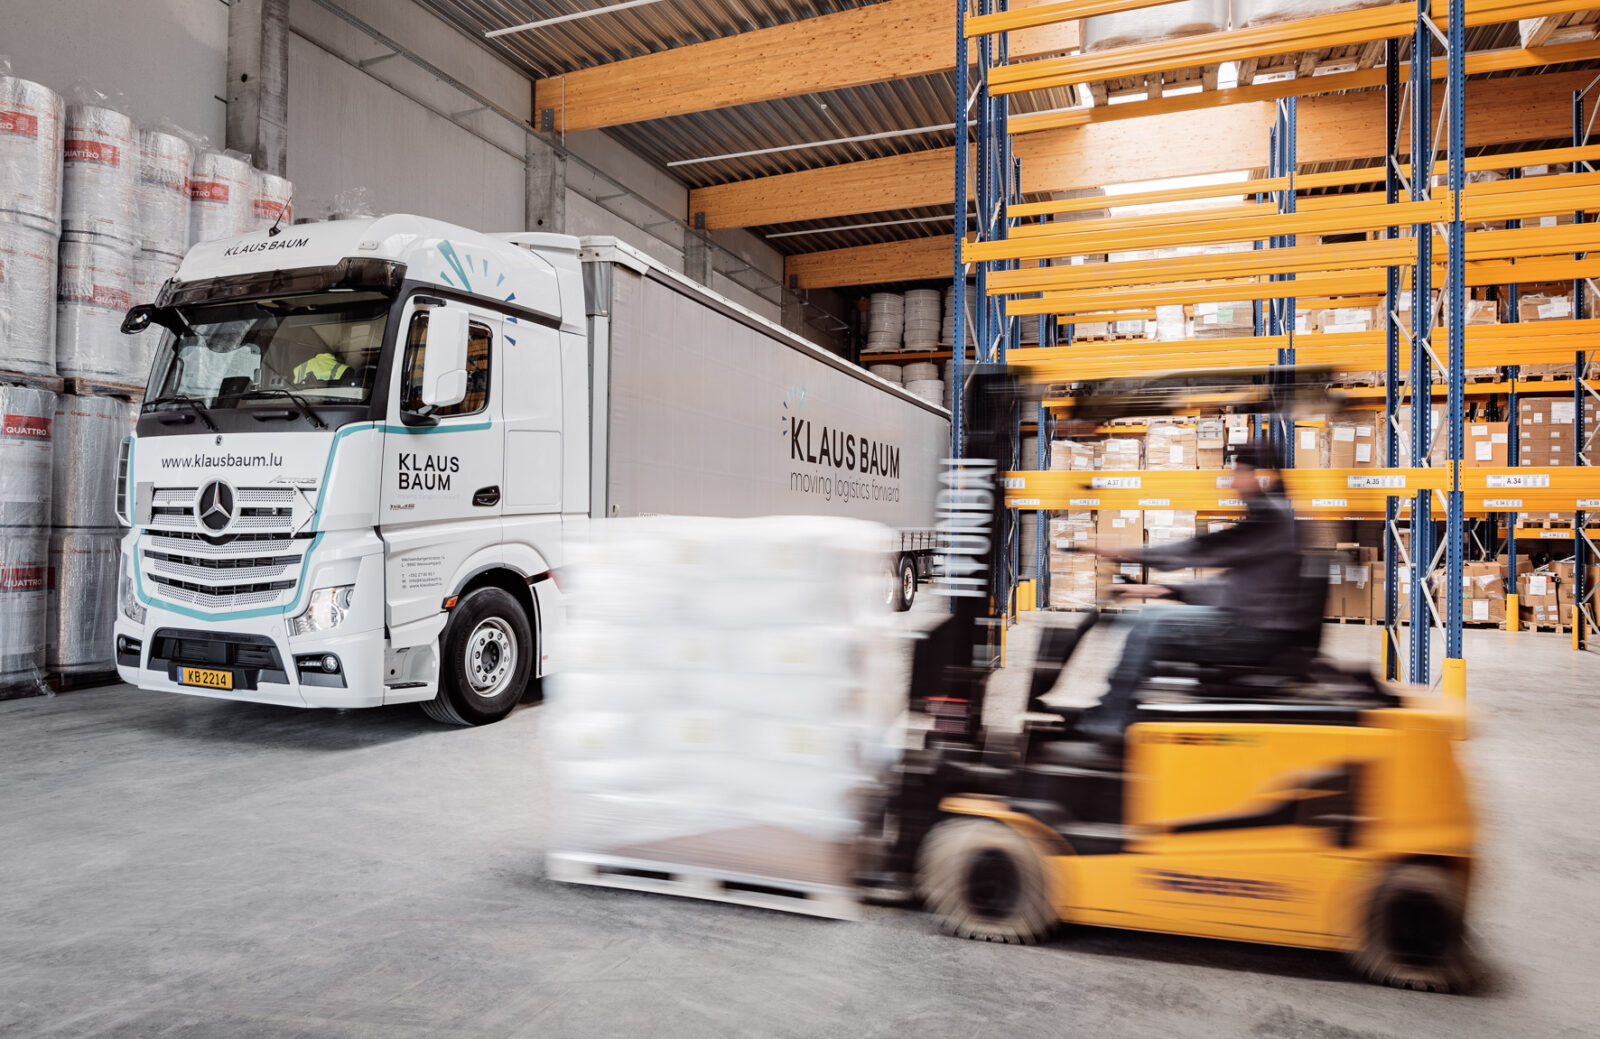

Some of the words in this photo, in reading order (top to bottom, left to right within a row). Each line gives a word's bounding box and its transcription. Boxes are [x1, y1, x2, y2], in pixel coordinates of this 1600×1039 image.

[224, 242, 268, 257] KLAUS
[268, 238, 309, 250] BAUM
[6, 426, 47, 436] QUATTRO
[791, 416, 856, 471] KLAUS
[860, 437, 900, 480] BAUM
[161, 452, 283, 468] www.klausbaum.lu
[399, 453, 460, 473] KLAUS
[399, 472, 451, 491] BAUM
[791, 470, 832, 502] moving
[834, 472, 871, 504] logistics
[872, 478, 900, 503] forward
[1506, 477, 1522, 485] A.34
[930, 458, 998, 597] HYUNDAI
